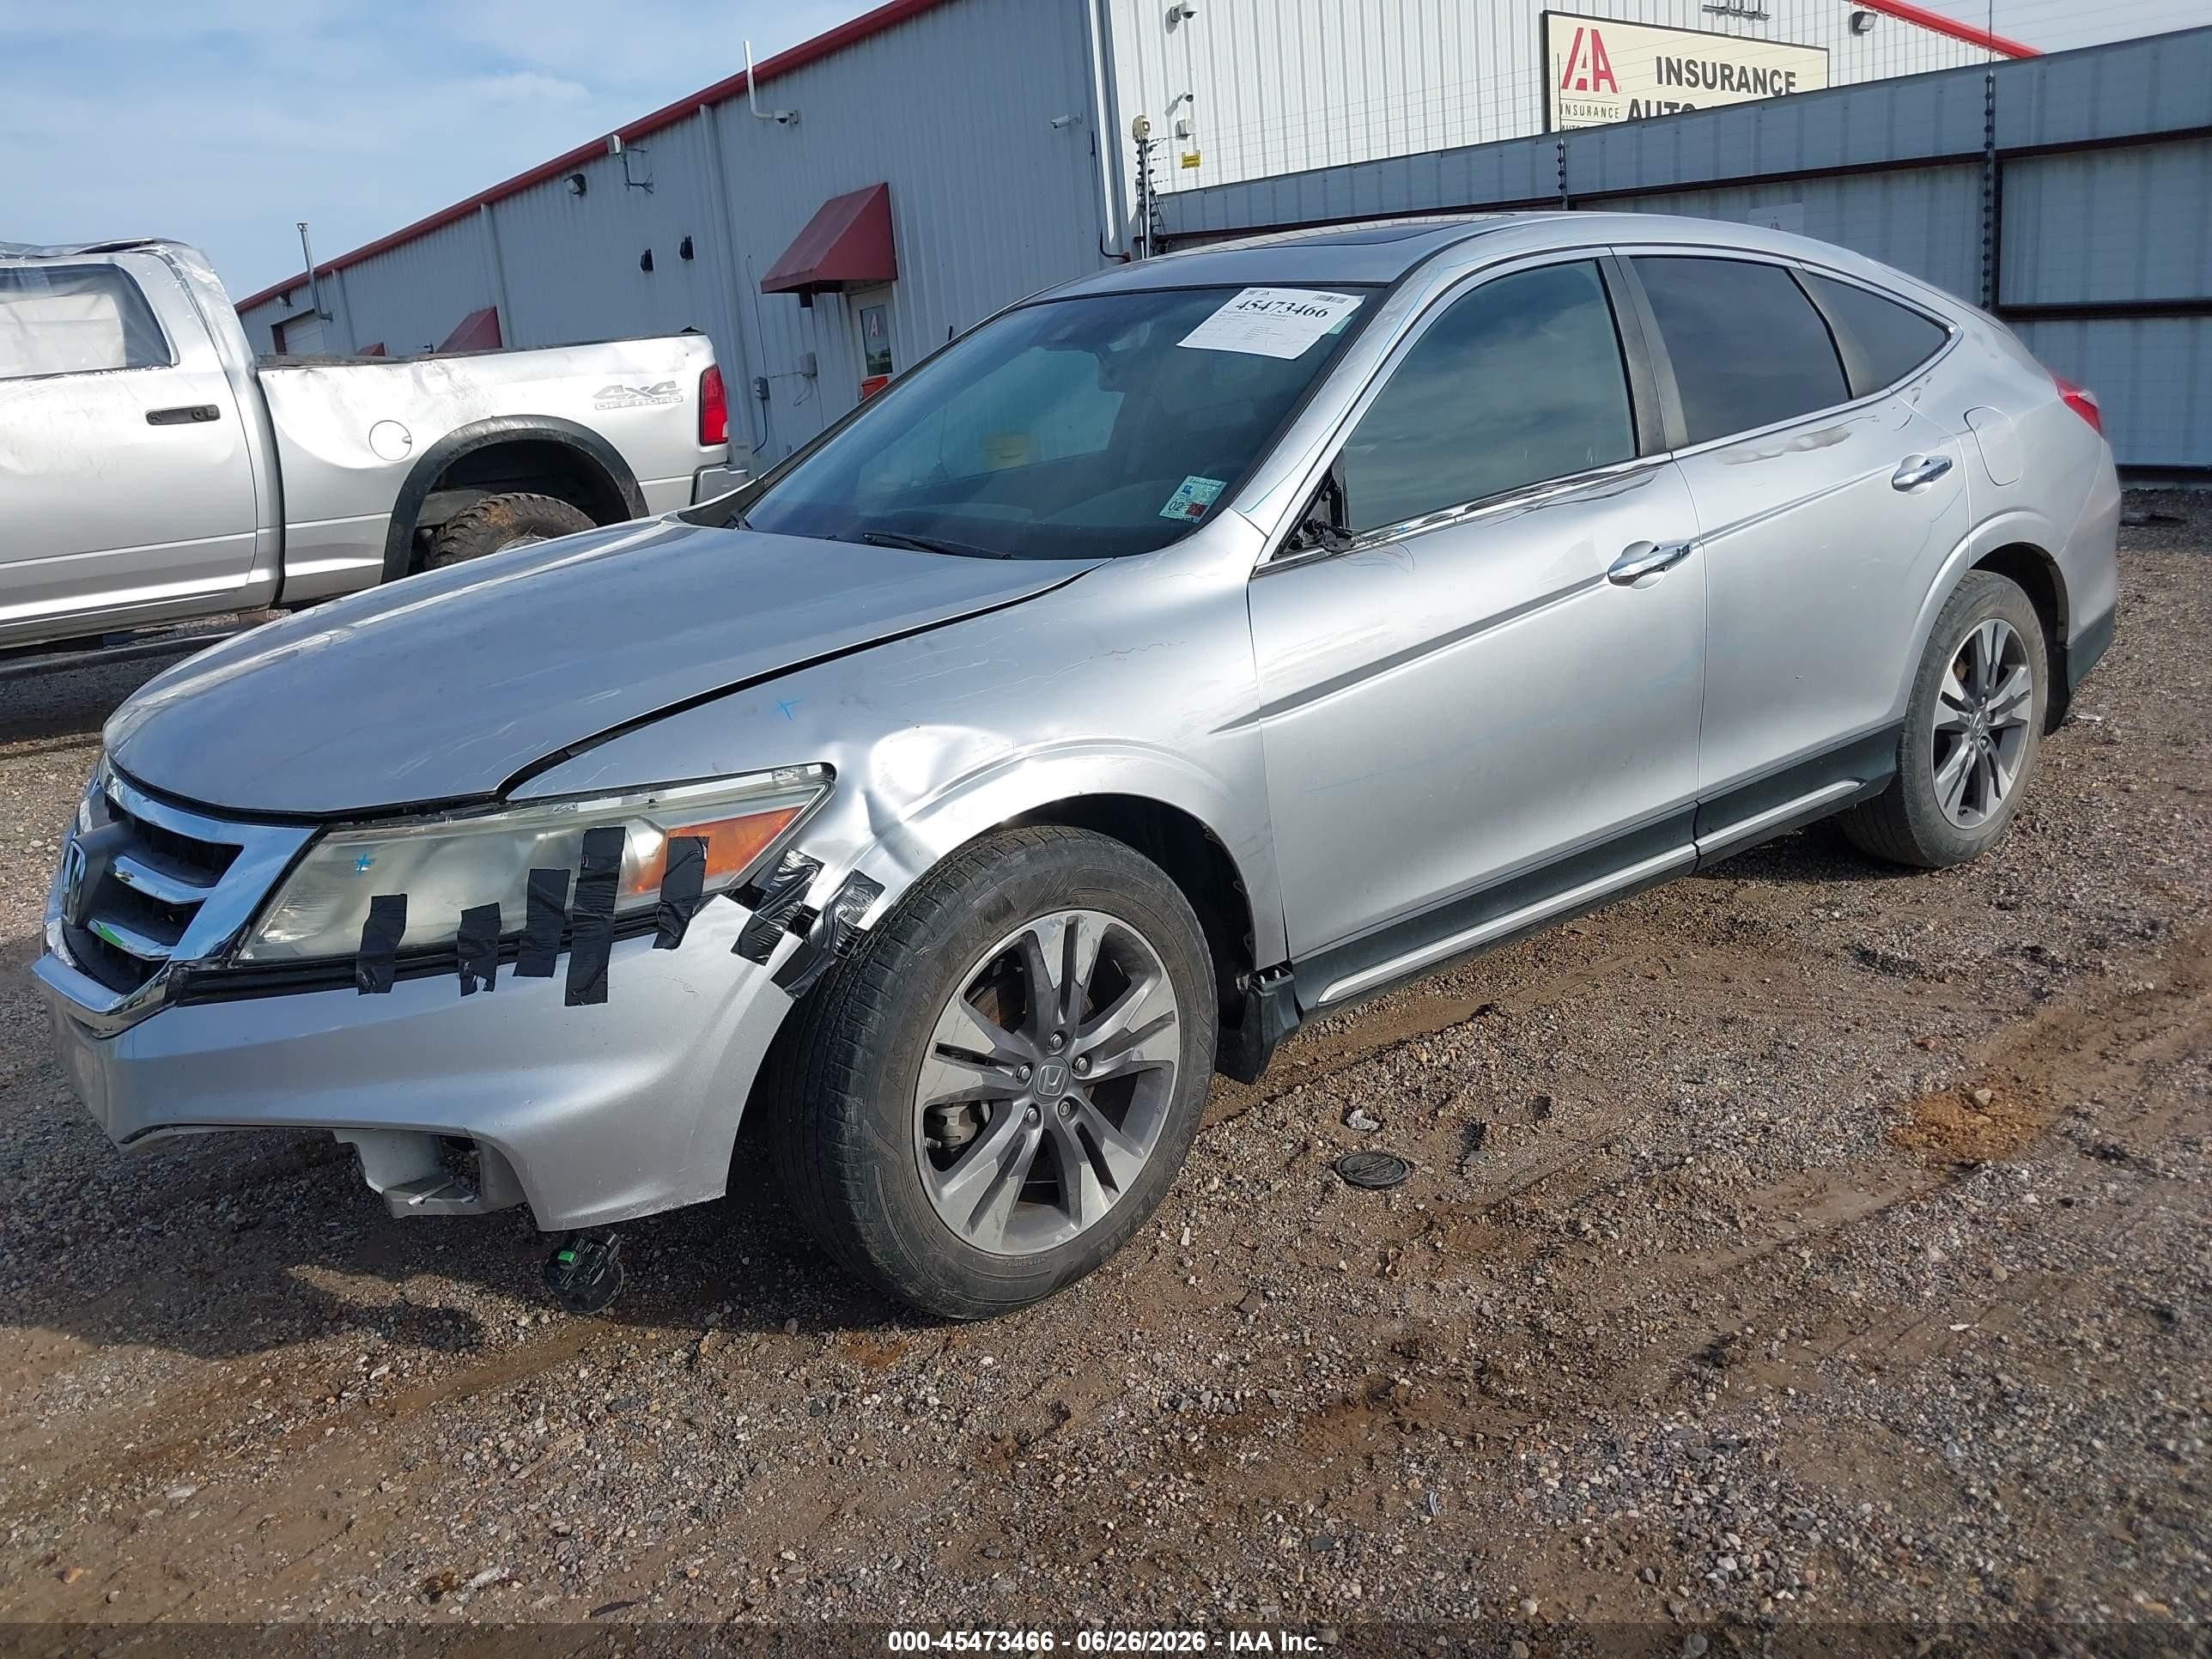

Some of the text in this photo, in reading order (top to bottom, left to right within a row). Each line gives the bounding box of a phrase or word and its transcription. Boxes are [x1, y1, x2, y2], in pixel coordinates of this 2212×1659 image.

[1656, 56, 1796, 97] INSURANCE
[1560, 103, 1620, 118] INSURANCE
[1628, 99, 1697, 121] AUT
[1236, 300, 1334, 319] 45473466
